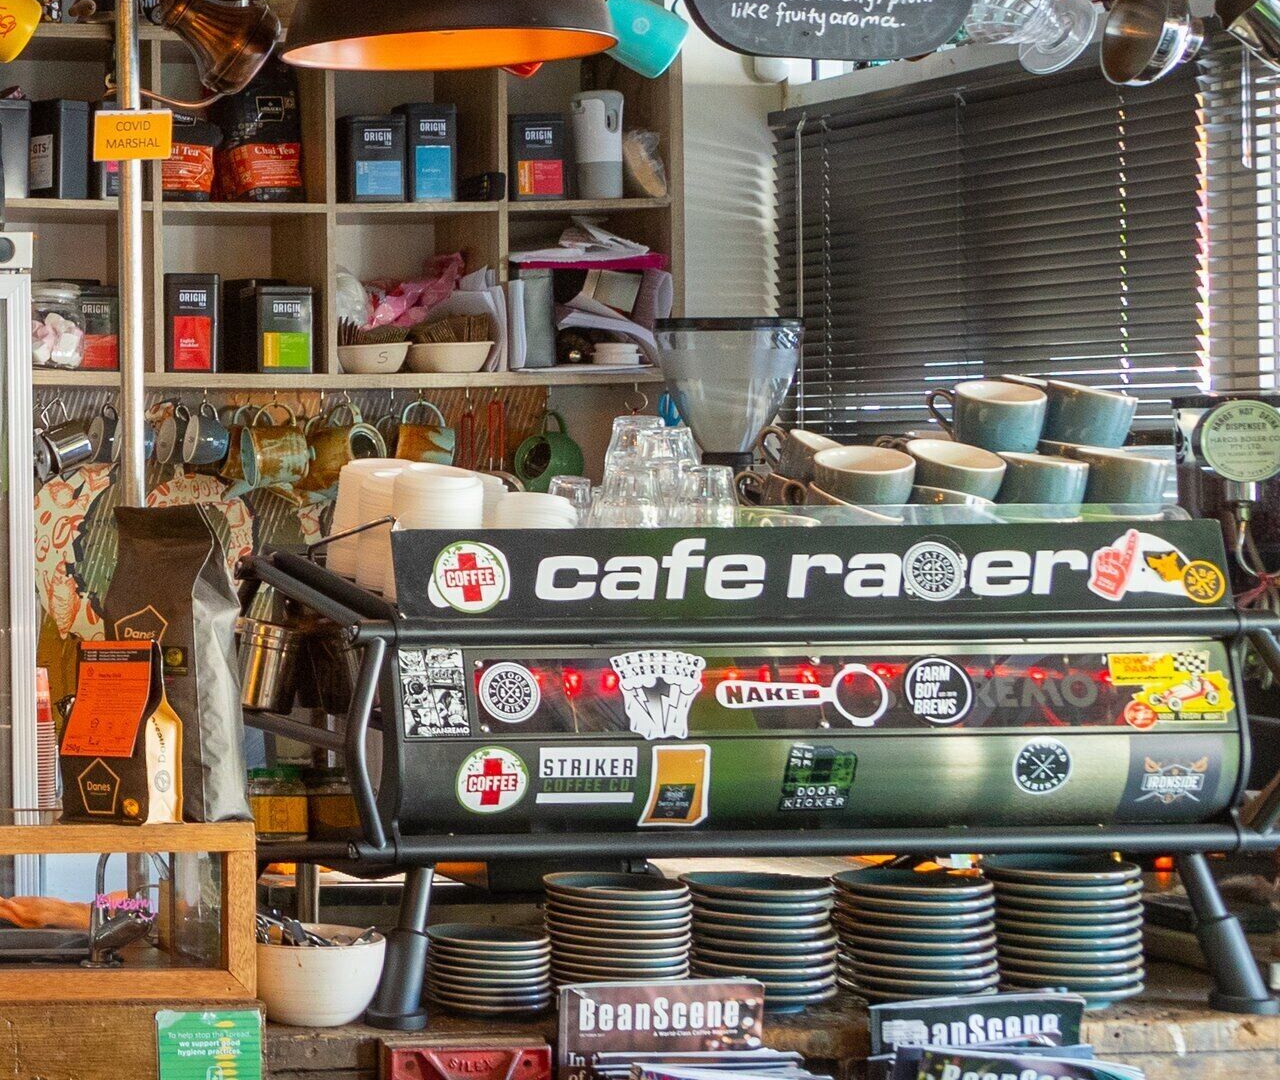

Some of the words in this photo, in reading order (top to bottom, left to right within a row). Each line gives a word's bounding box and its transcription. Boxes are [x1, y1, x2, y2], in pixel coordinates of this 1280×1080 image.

[776, 1, 828, 36] fruity
[116, 121, 151, 131] COVID
[420, 122, 445, 132] ORIGIN
[525, 130, 552, 140] ORIGIN
[106, 137, 160, 148] MARSHAL
[254, 146, 274, 156] Chai
[276, 146, 295, 155] Tea
[179, 293, 206, 302] ORIGIN
[535, 539, 766, 601] cafe
[789, 550, 1088, 597] raer
[445, 569, 495, 587] COFFEE
[915, 665, 951, 682] FARM
[914, 683, 938, 699] BOY
[914, 699, 956, 715] BREWS
[431, 727, 470, 735] SANREMO
[543, 758, 634, 777] STRIKER
[87, 781, 111, 792] Danes
[468, 775, 518, 791] COFFEE
[543, 778, 602, 792] COFFEE
[609, 778, 631, 791] CO
[1147, 776, 1199, 789] IRONSIDE
[797, 786, 837, 796] DOOR
[784, 797, 845, 808] KICKER
[578, 996, 740, 1032] BeanScene
[177, 1048, 207, 1056] hygiene
[448, 1058, 496, 1073] SILEX
